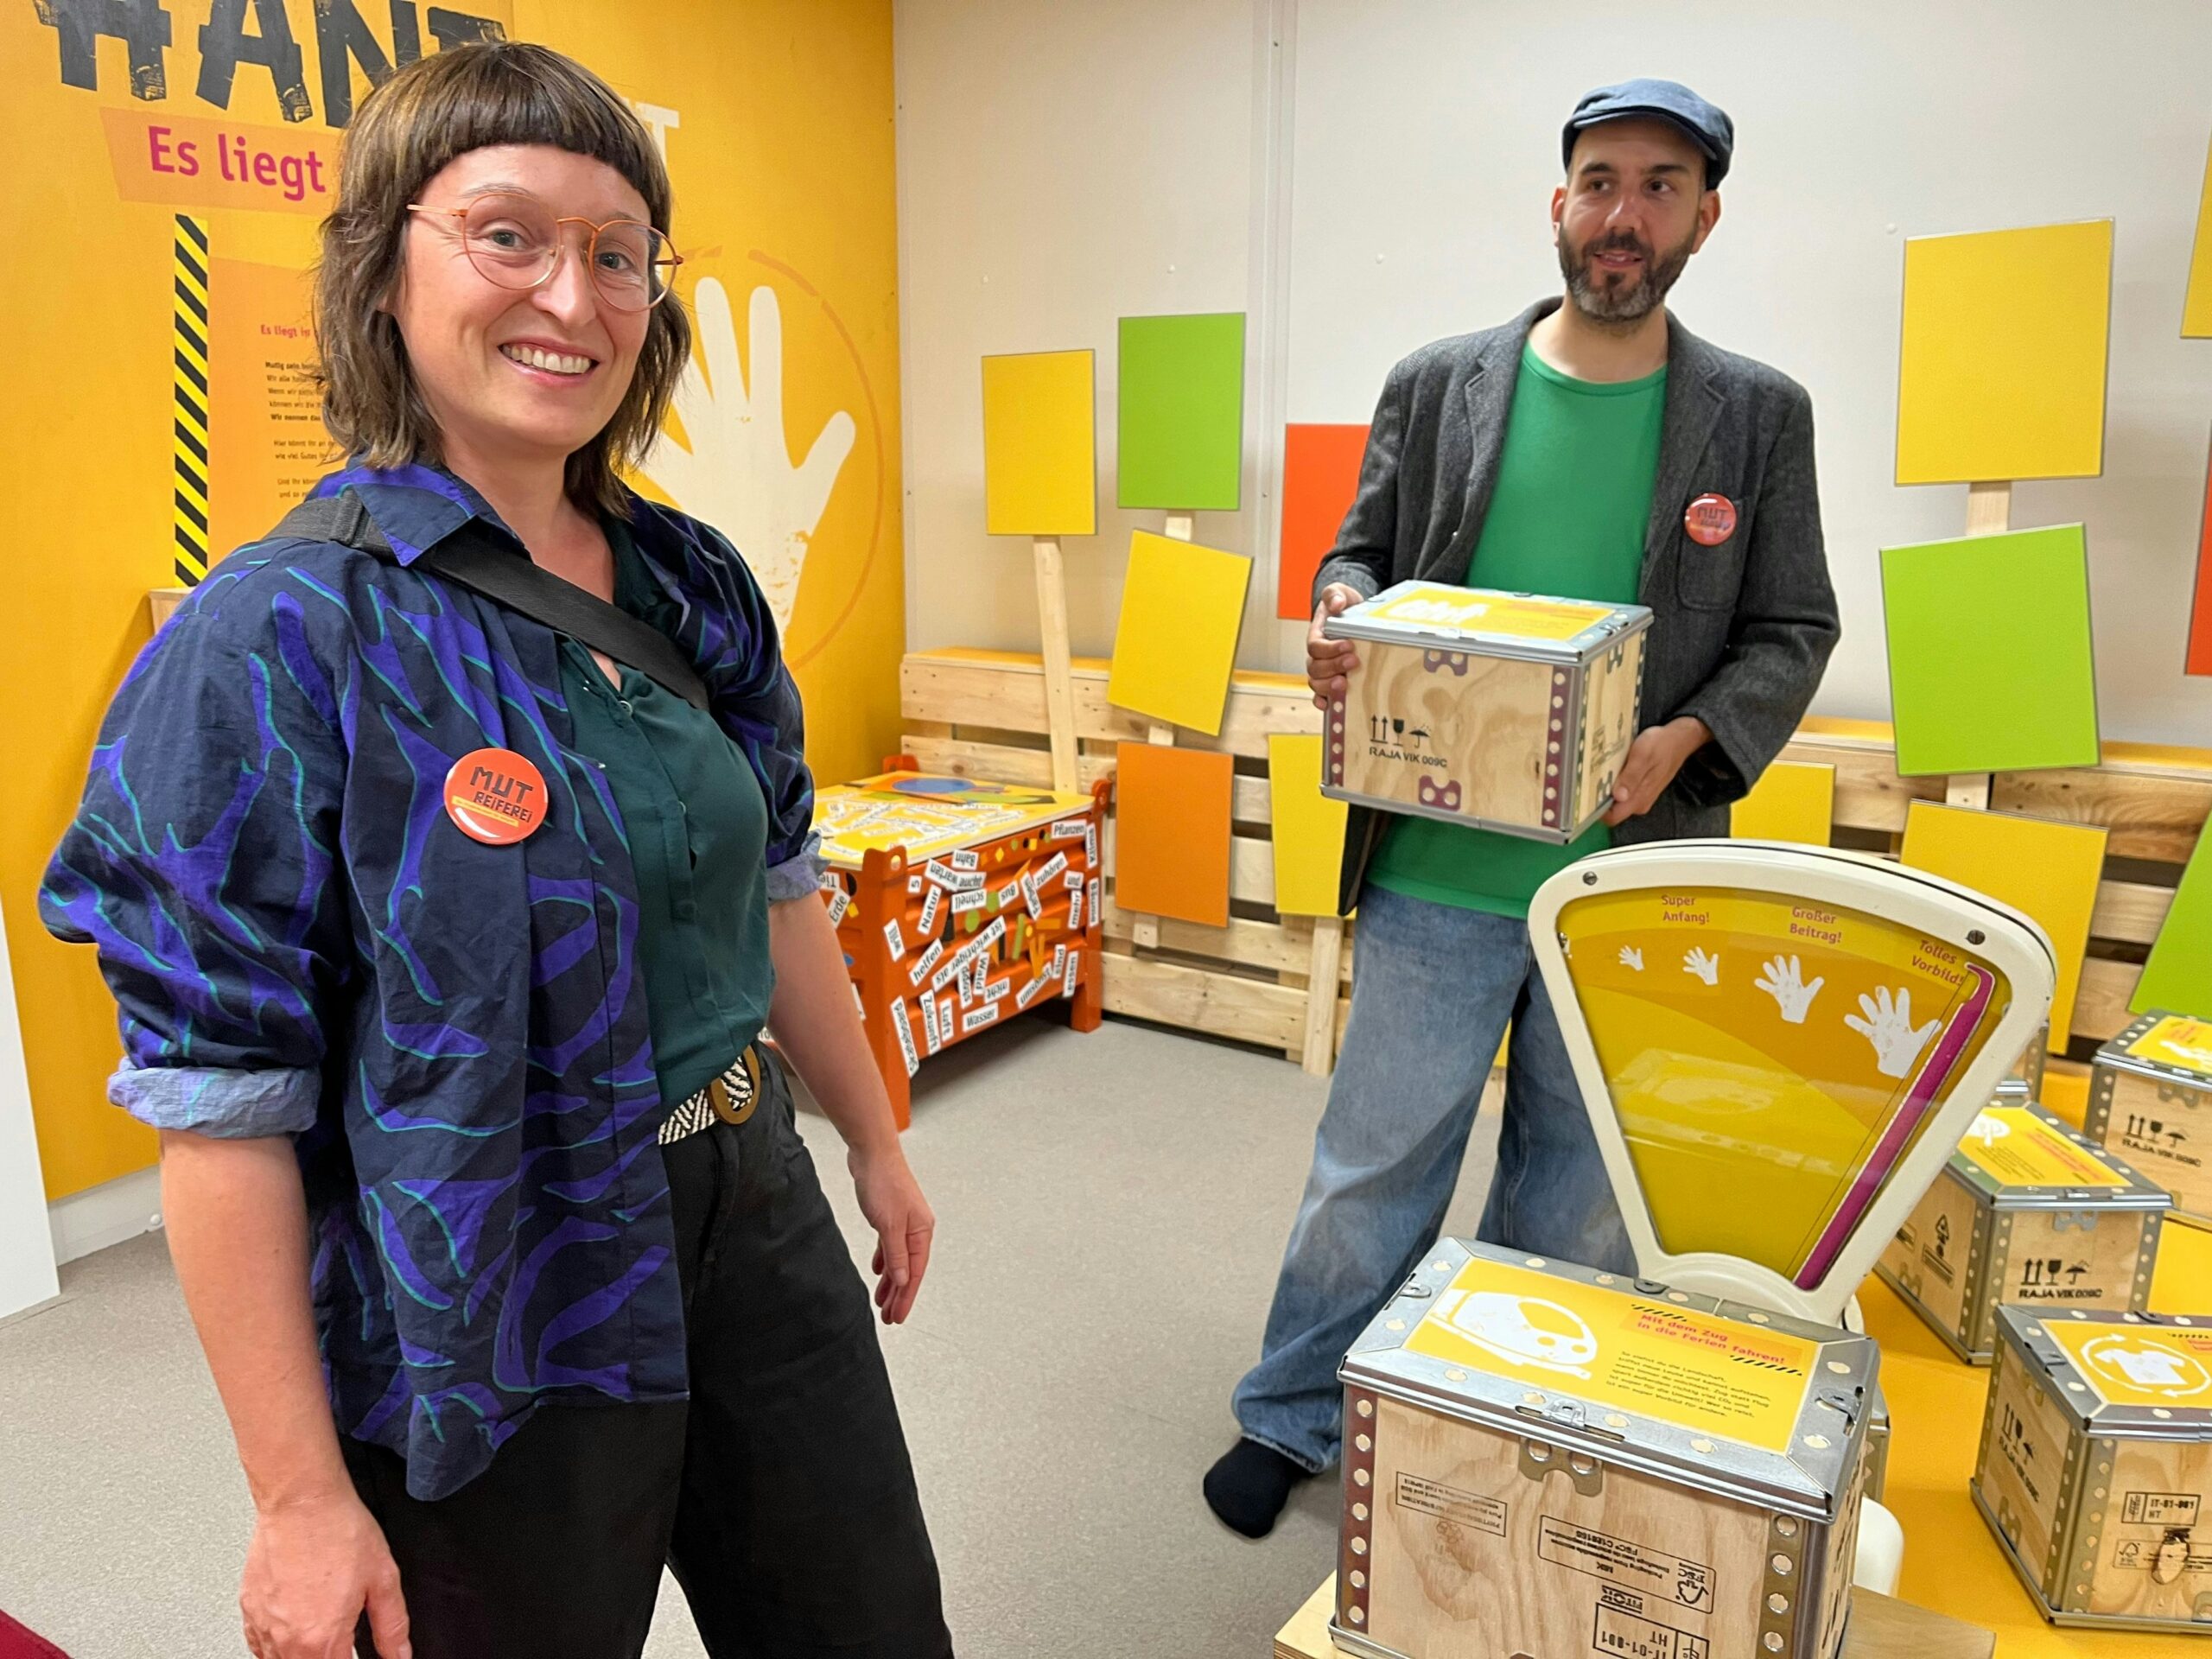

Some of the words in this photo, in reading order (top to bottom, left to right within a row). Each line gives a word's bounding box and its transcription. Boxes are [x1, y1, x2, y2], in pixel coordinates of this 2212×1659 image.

[148, 125, 200, 176] Es
[219, 133, 326, 201] liegt
[261, 324, 270, 334] Es
[275, 326, 296, 338] liegt
[1369, 747, 1402, 761] RAJA
[1403, 753, 1420, 763] VIK
[469, 766, 534, 804] MUT
[1054, 823, 1085, 836] Pflanzen
[955, 852, 976, 867] Bahn
[821, 875, 836, 887] Tie
[931, 863, 958, 884] warten
[1037, 857, 1065, 885] zuhören
[955, 891, 984, 909] schnell
[1001, 884, 1015, 899] Bus
[1662, 895, 1695, 908] Super
[830, 895, 847, 922] Erde
[922, 890, 938, 929] Natur
[1663, 911, 1710, 925] Anfang!
[1791, 906, 1836, 925] Großer
[1789, 923, 1842, 944] Beitrag!
[1919, 938, 1957, 965] Tolles
[913, 945, 941, 980] helfen
[1911, 957, 1965, 986] Vorbild!
[976, 957, 986, 989] Wald
[1067, 957, 1076, 991] essen
[987, 981, 1007, 998] nicht
[925, 996, 938, 1051] Zukunft
[942, 1007, 951, 1035] Luft
[967, 1008, 995, 1027] Wasser
[2122, 1138, 2155, 1154] RAJA
[2018, 1287, 2056, 1299] RAJA
[2056, 1288, 2074, 1298] VIK
[1641, 1314, 1662, 1324] Mit
[1667, 1321, 1697, 1332] dem
[1700, 1329, 1728, 1341] Zug
[1655, 1325, 1677, 1336] die
[1682, 1332, 1727, 1348] Ferien
[1732, 1344, 1785, 1363] fahren!
[1677, 1567, 1705, 1583] FSC
[1649, 1631, 1668, 1647] HT
